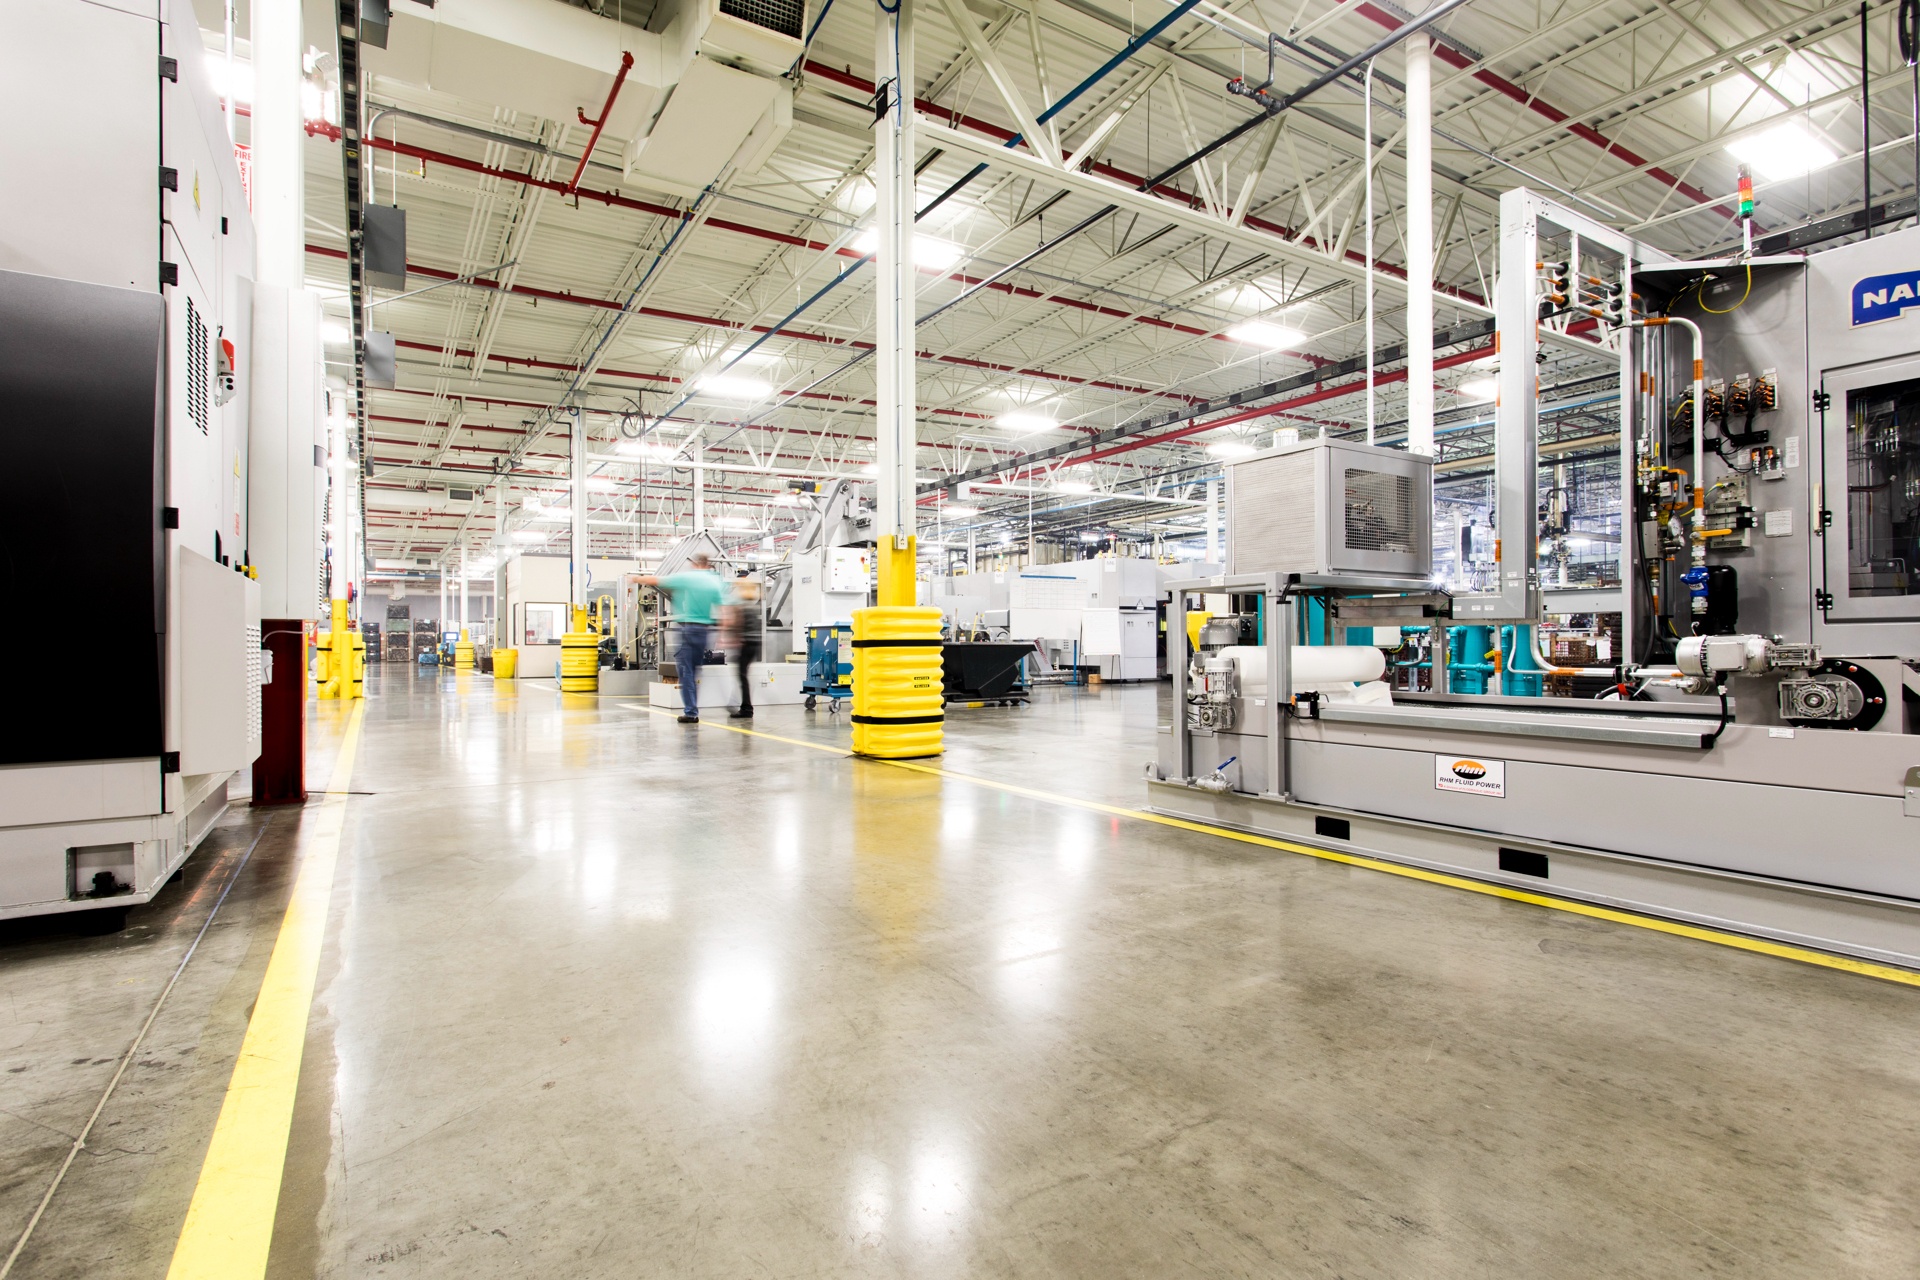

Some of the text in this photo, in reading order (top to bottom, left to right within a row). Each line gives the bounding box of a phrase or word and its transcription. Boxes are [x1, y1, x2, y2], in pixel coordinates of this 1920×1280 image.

[234, 149, 251, 160] FIRE
[1862, 280, 1920, 309] NA
[1455, 778, 1475, 786] FLUID
[1475, 780, 1502, 789] POWER
